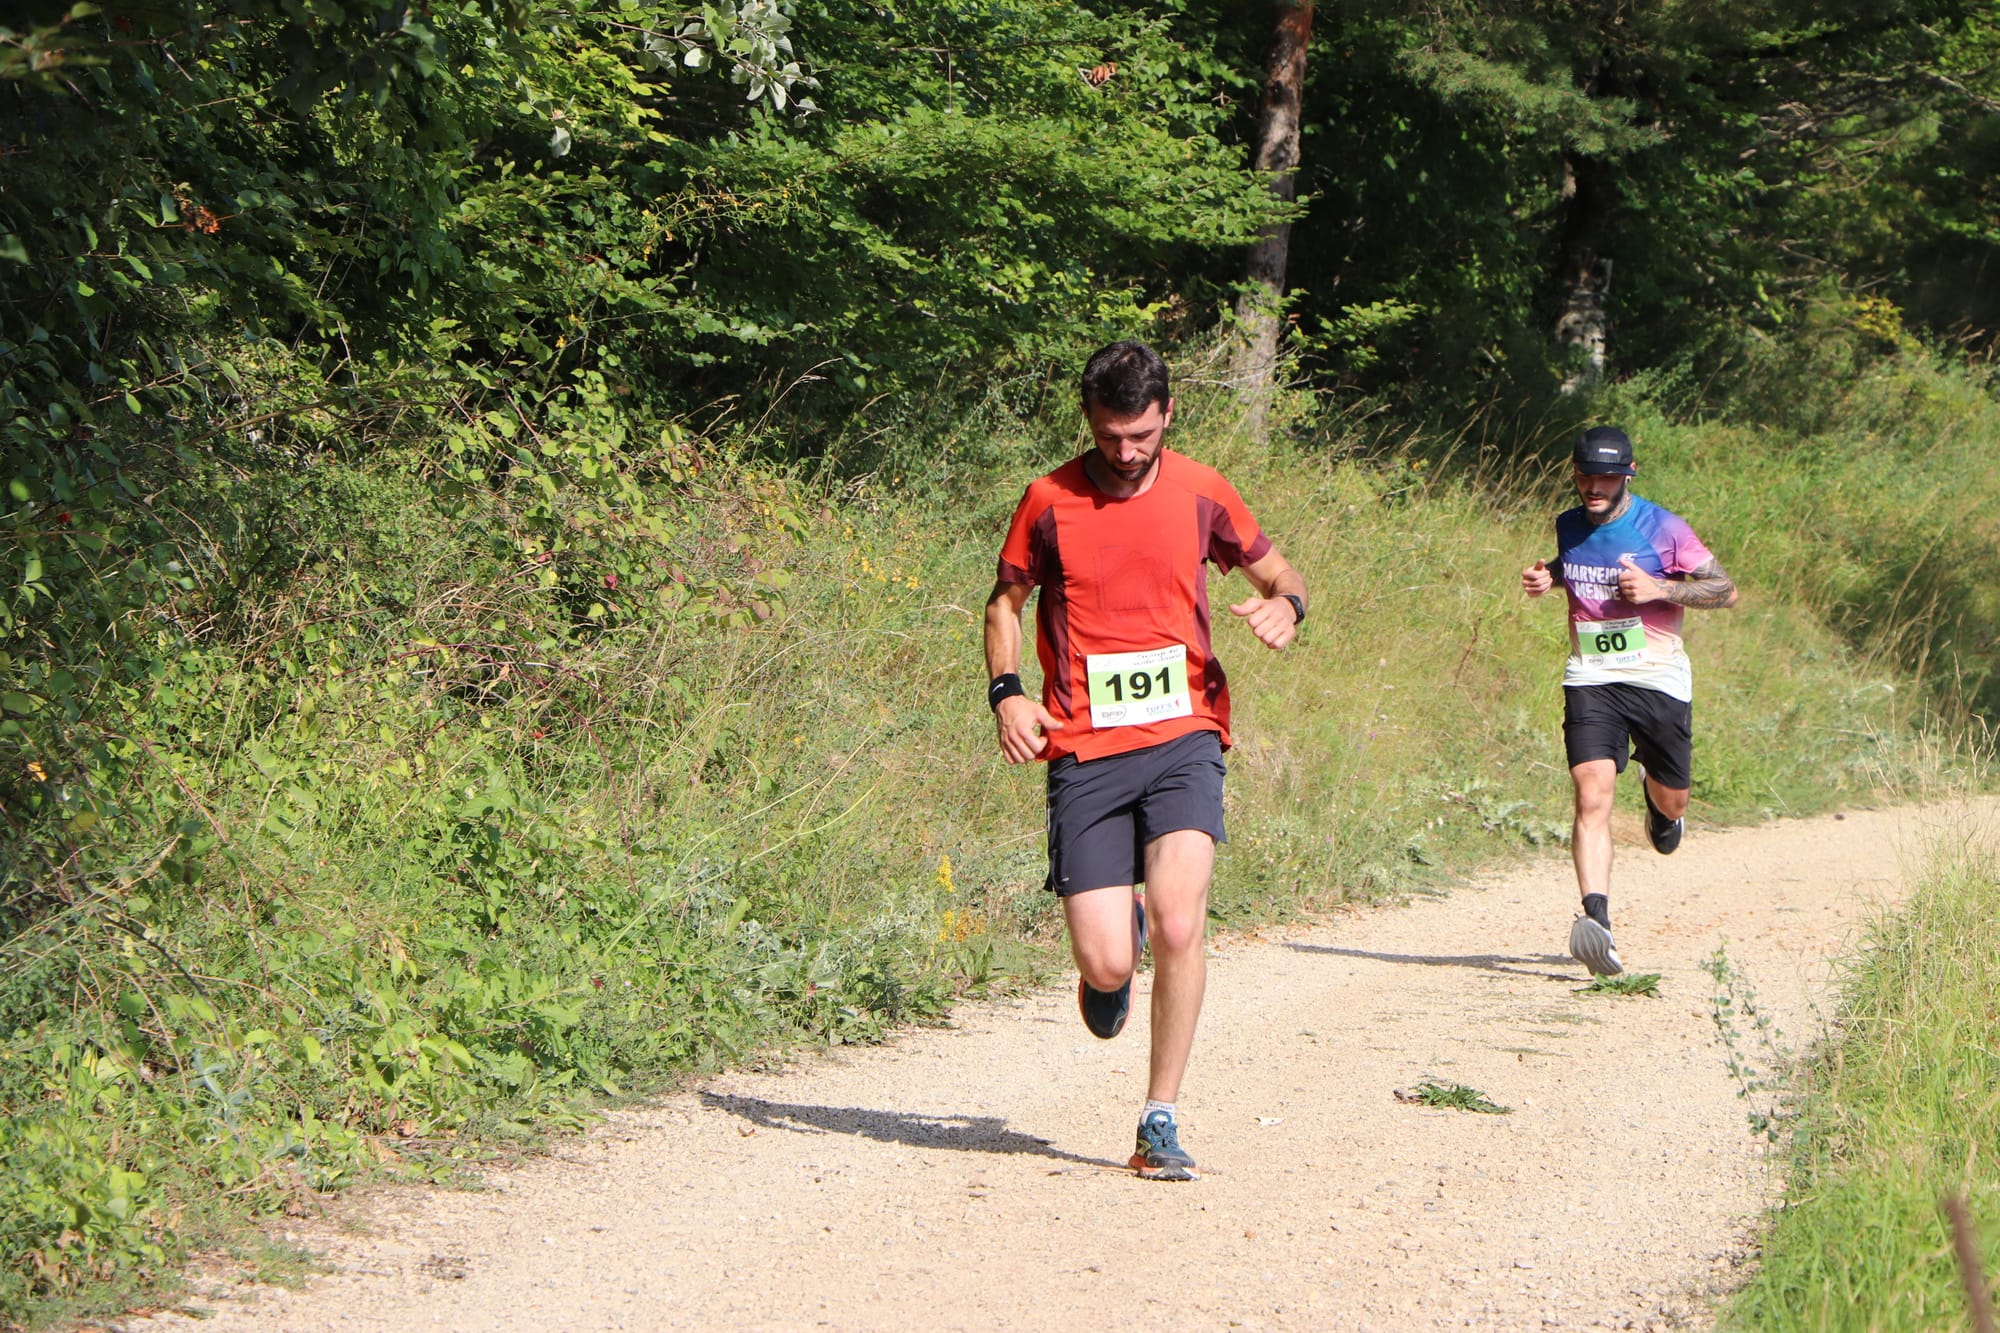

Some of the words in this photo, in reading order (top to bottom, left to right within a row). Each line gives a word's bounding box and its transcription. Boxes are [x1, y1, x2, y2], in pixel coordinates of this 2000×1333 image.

[1575, 582, 1621, 600] MENDE
[1595, 632, 1627, 653] 60
[1105, 666, 1171, 702] 191
